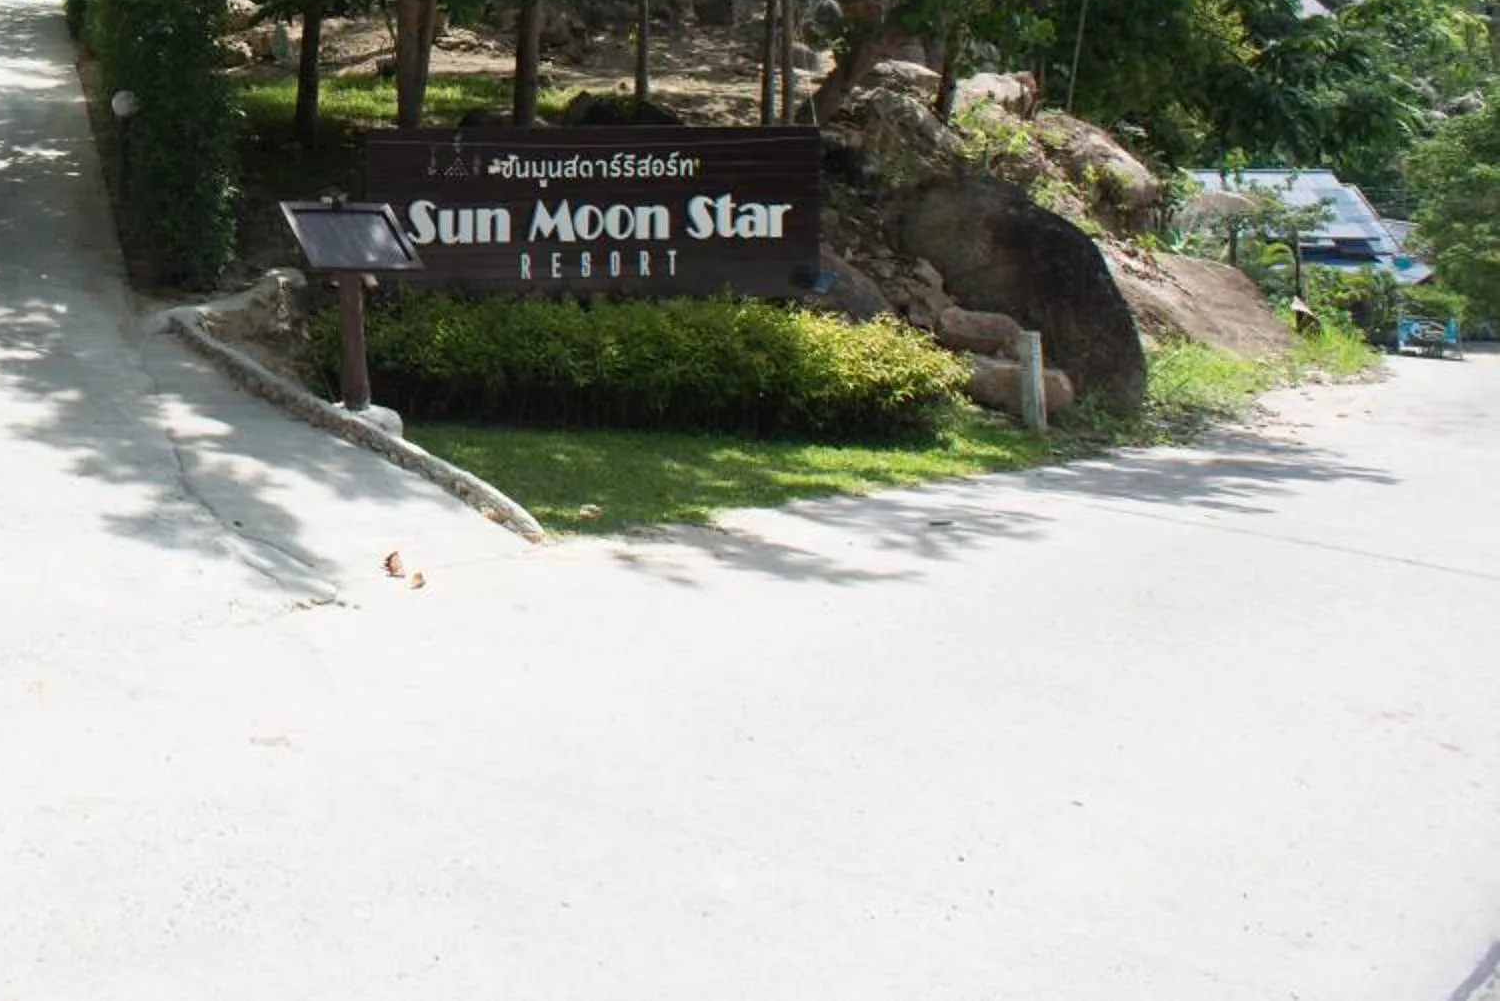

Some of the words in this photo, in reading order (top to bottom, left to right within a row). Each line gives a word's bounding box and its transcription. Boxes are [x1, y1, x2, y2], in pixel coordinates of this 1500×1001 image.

[406, 199, 511, 245] Sun
[528, 198, 670, 242] Moon
[686, 192, 792, 240] Star
[520, 249, 677, 280] RESORT
